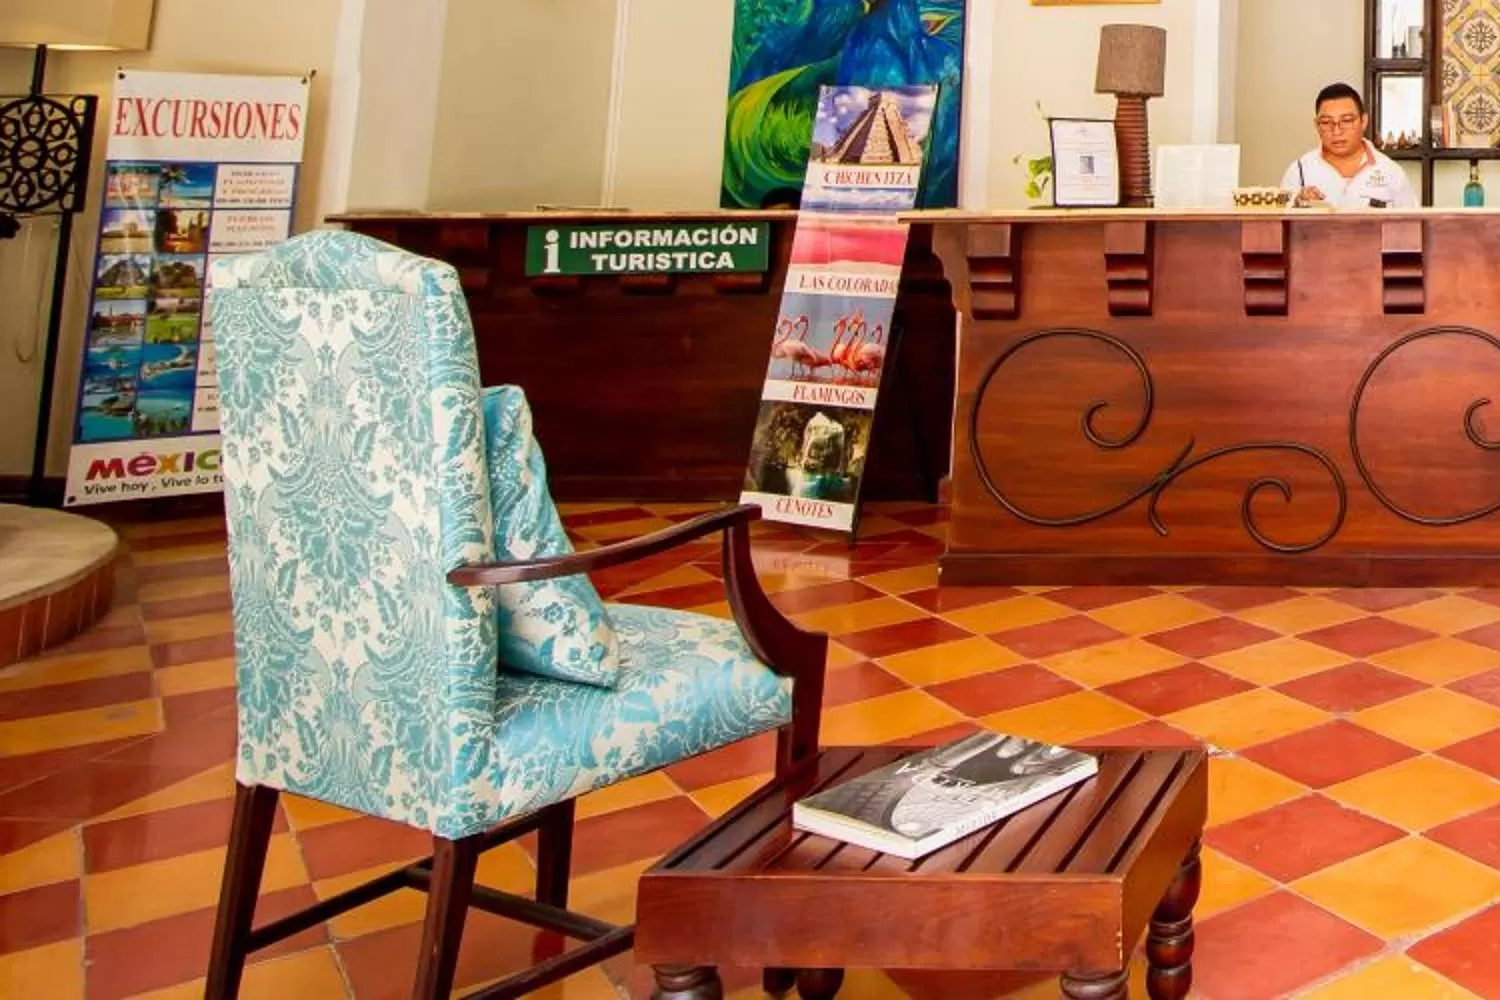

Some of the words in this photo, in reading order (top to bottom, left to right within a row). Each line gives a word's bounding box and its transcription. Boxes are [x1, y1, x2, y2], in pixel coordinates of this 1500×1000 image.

[114, 97, 301, 141] EXCURSIONES
[570, 224, 758, 249] INFORMACIÓN
[591, 251, 735, 271] TURISTICA
[800, 274, 826, 289] LAS
[827, 277, 896, 293] COLORADA
[793, 384, 866, 405] FLAMINGOS
[84, 484, 117, 495] Vive
[776, 499, 833, 518] CENOTES
